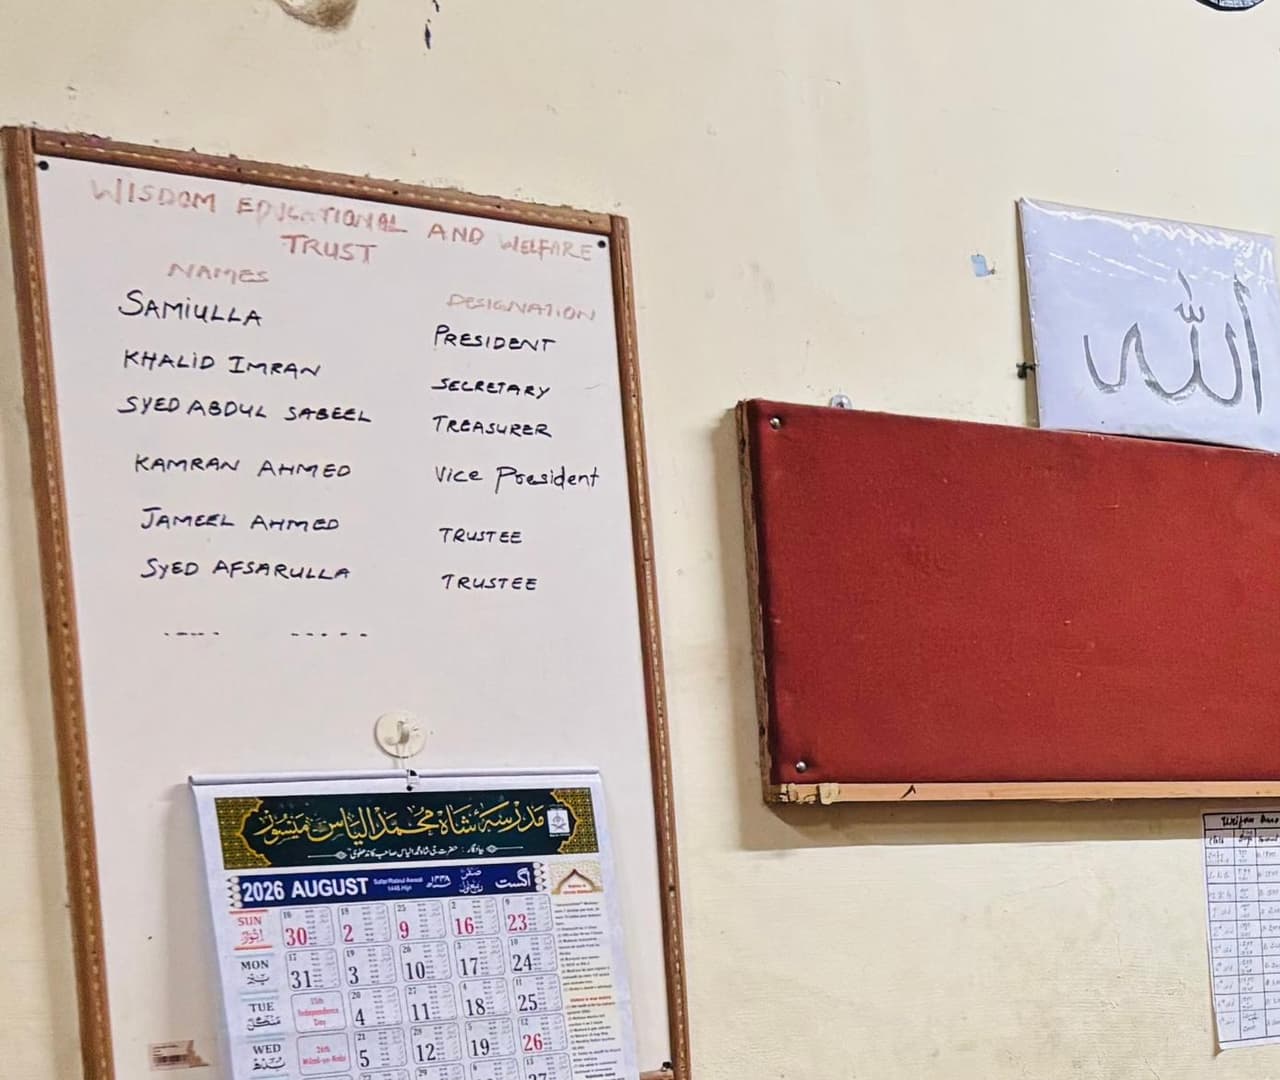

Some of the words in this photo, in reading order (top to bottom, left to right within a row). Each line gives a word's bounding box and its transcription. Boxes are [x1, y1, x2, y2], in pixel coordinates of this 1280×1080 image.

[90, 177, 217, 213] WISDOM
[426, 223, 485, 246] AND
[499, 234, 593, 263] WELFARE
[280, 233, 377, 265] TRUST
[167, 261, 270, 286] NAMES
[446, 292, 597, 323] DESIGNATION
[434, 324, 557, 352] PRESIDENT
[125, 350, 215, 373] KHALID
[229, 354, 321, 378] IMRAN
[432, 377, 551, 400] SECRETARY
[119, 395, 180, 415] SYED
[187, 396, 266, 420] ABDUL
[432, 415, 552, 439] TREASURER
[135, 454, 241, 476] KAMRAN
[257, 459, 351, 479] AHMED
[435, 466, 484, 484] Vice
[495, 466, 600, 495] President
[141, 507, 235, 531] JAMEEL
[250, 512, 340, 533] AHMED
[439, 527, 523, 545] TRUSTEE
[141, 556, 198, 579] SYED
[212, 558, 350, 580] AFSARULLA
[440, 574, 539, 591] TRUSTEE
[242, 881, 285, 902] 2026
[292, 878, 369, 898] AUGUST
[238, 917, 262, 926] SUN
[399, 921, 409, 939] 9
[455, 917, 474, 934] 16
[508, 913, 528, 932] 23
[285, 927, 307, 945] 30
[343, 924, 354, 942] 2
[241, 960, 269, 970] MON
[406, 961, 425, 980] 10
[460, 958, 478, 976] 17
[513, 954, 532, 972] 24
[291, 970, 312, 989] 31
[349, 966, 359, 985] 3
[250, 1002, 275, 1012] TUE
[412, 1003, 429, 1021] 11
[466, 998, 485, 1016] 18
[518, 994, 538, 1011] 25
[355, 1008, 365, 1026] 4
[253, 1044, 281, 1054] WED
[472, 1038, 490, 1057] 19
[523, 1033, 543, 1051] 26
[360, 1050, 370, 1068] 5
[416, 1043, 436, 1062] 12
